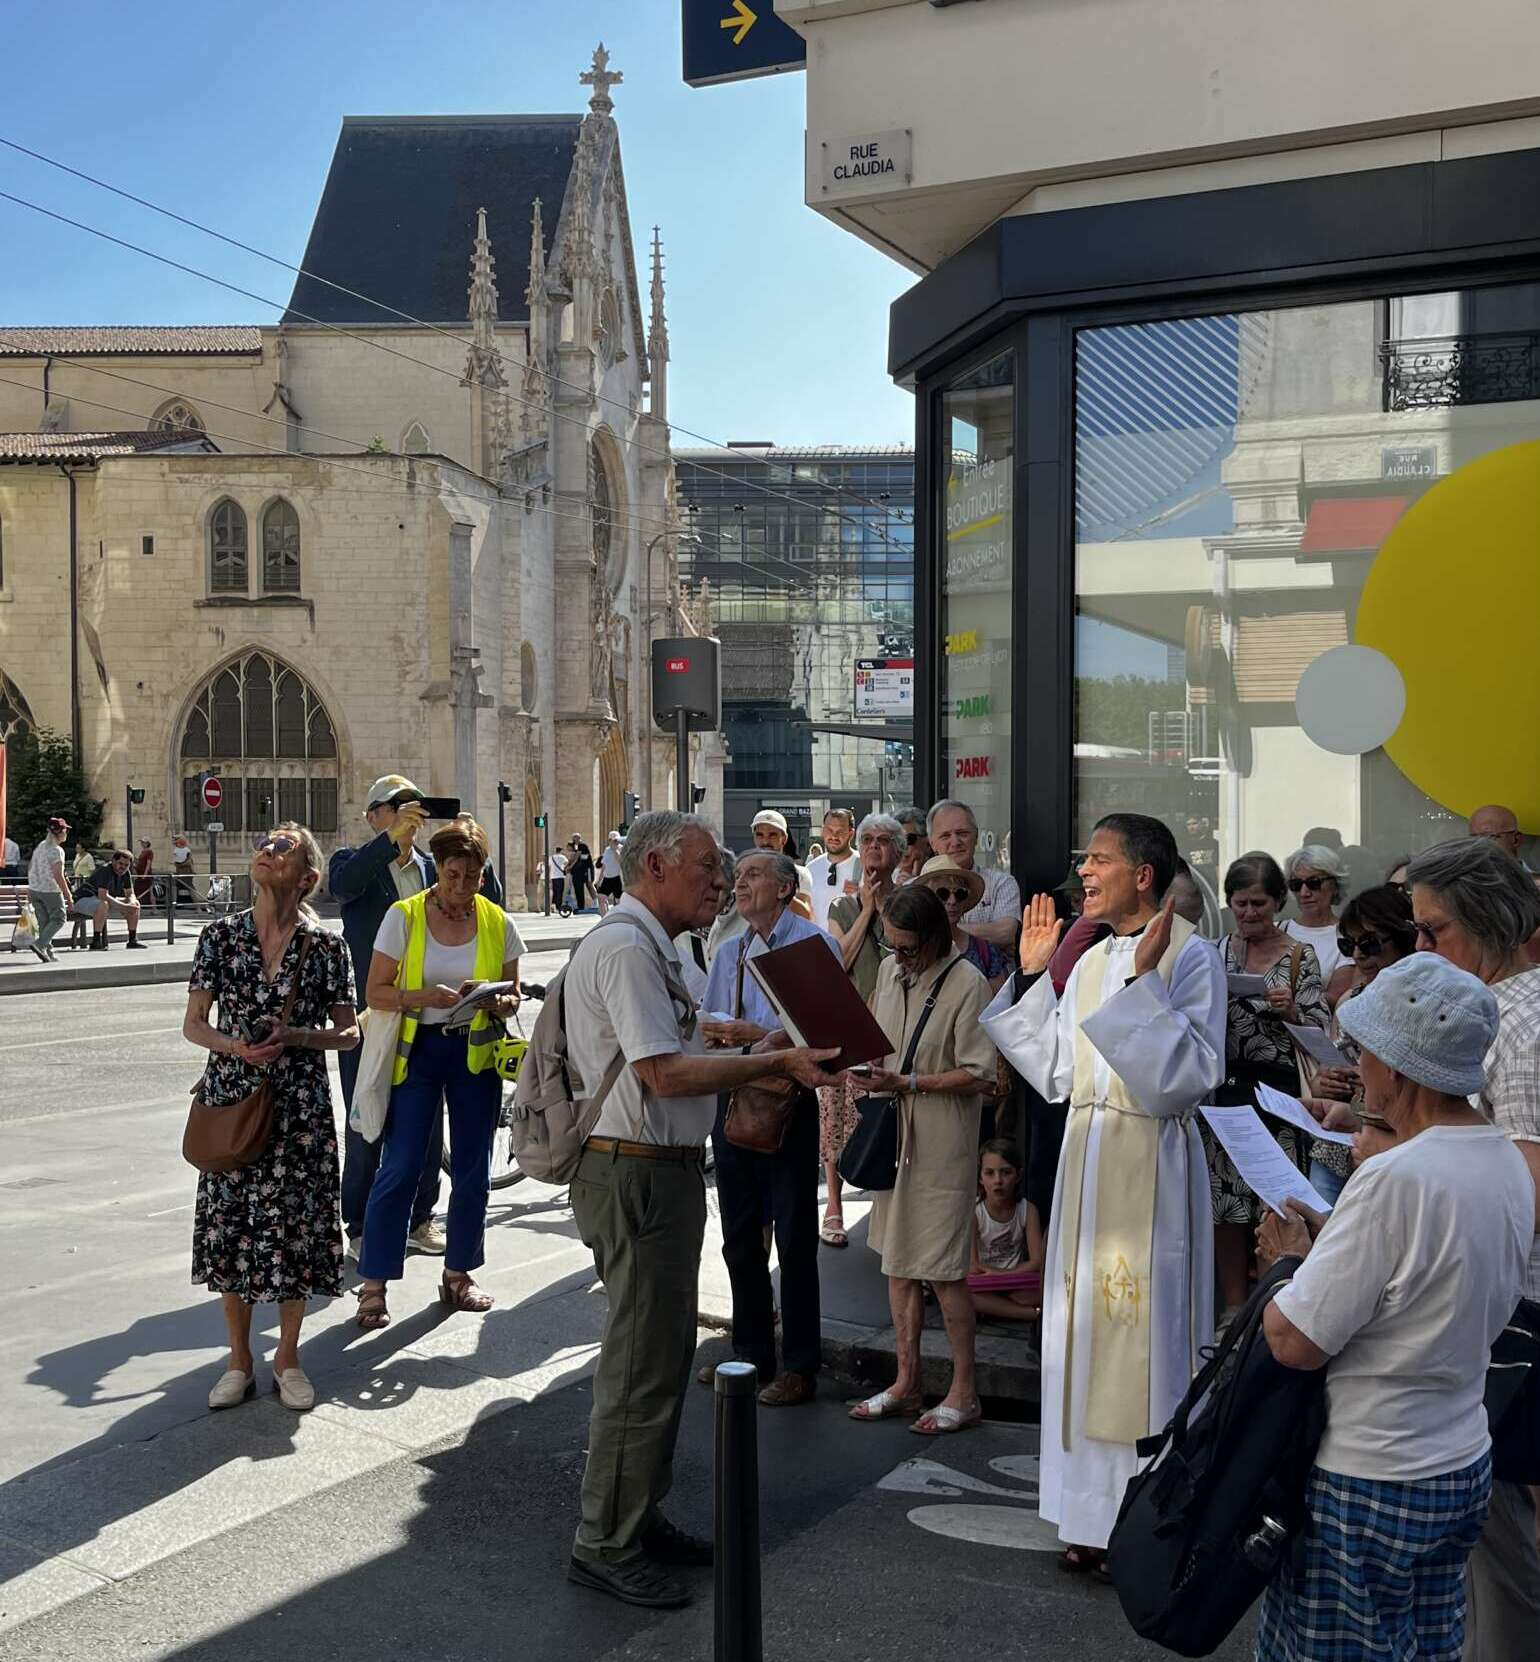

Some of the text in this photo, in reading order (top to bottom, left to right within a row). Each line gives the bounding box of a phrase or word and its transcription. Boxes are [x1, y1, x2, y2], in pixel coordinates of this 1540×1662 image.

[850, 142, 879, 160] RUE
[833, 157, 895, 180] CLAUDIA
[962, 454, 996, 488] Entrée
[946, 484, 1005, 531] BOUTIQUE
[945, 541, 1006, 578] ABONNEMENT
[671, 662, 685, 670] BUS
[955, 694, 991, 720] PARK
[955, 755, 991, 780] PARK
